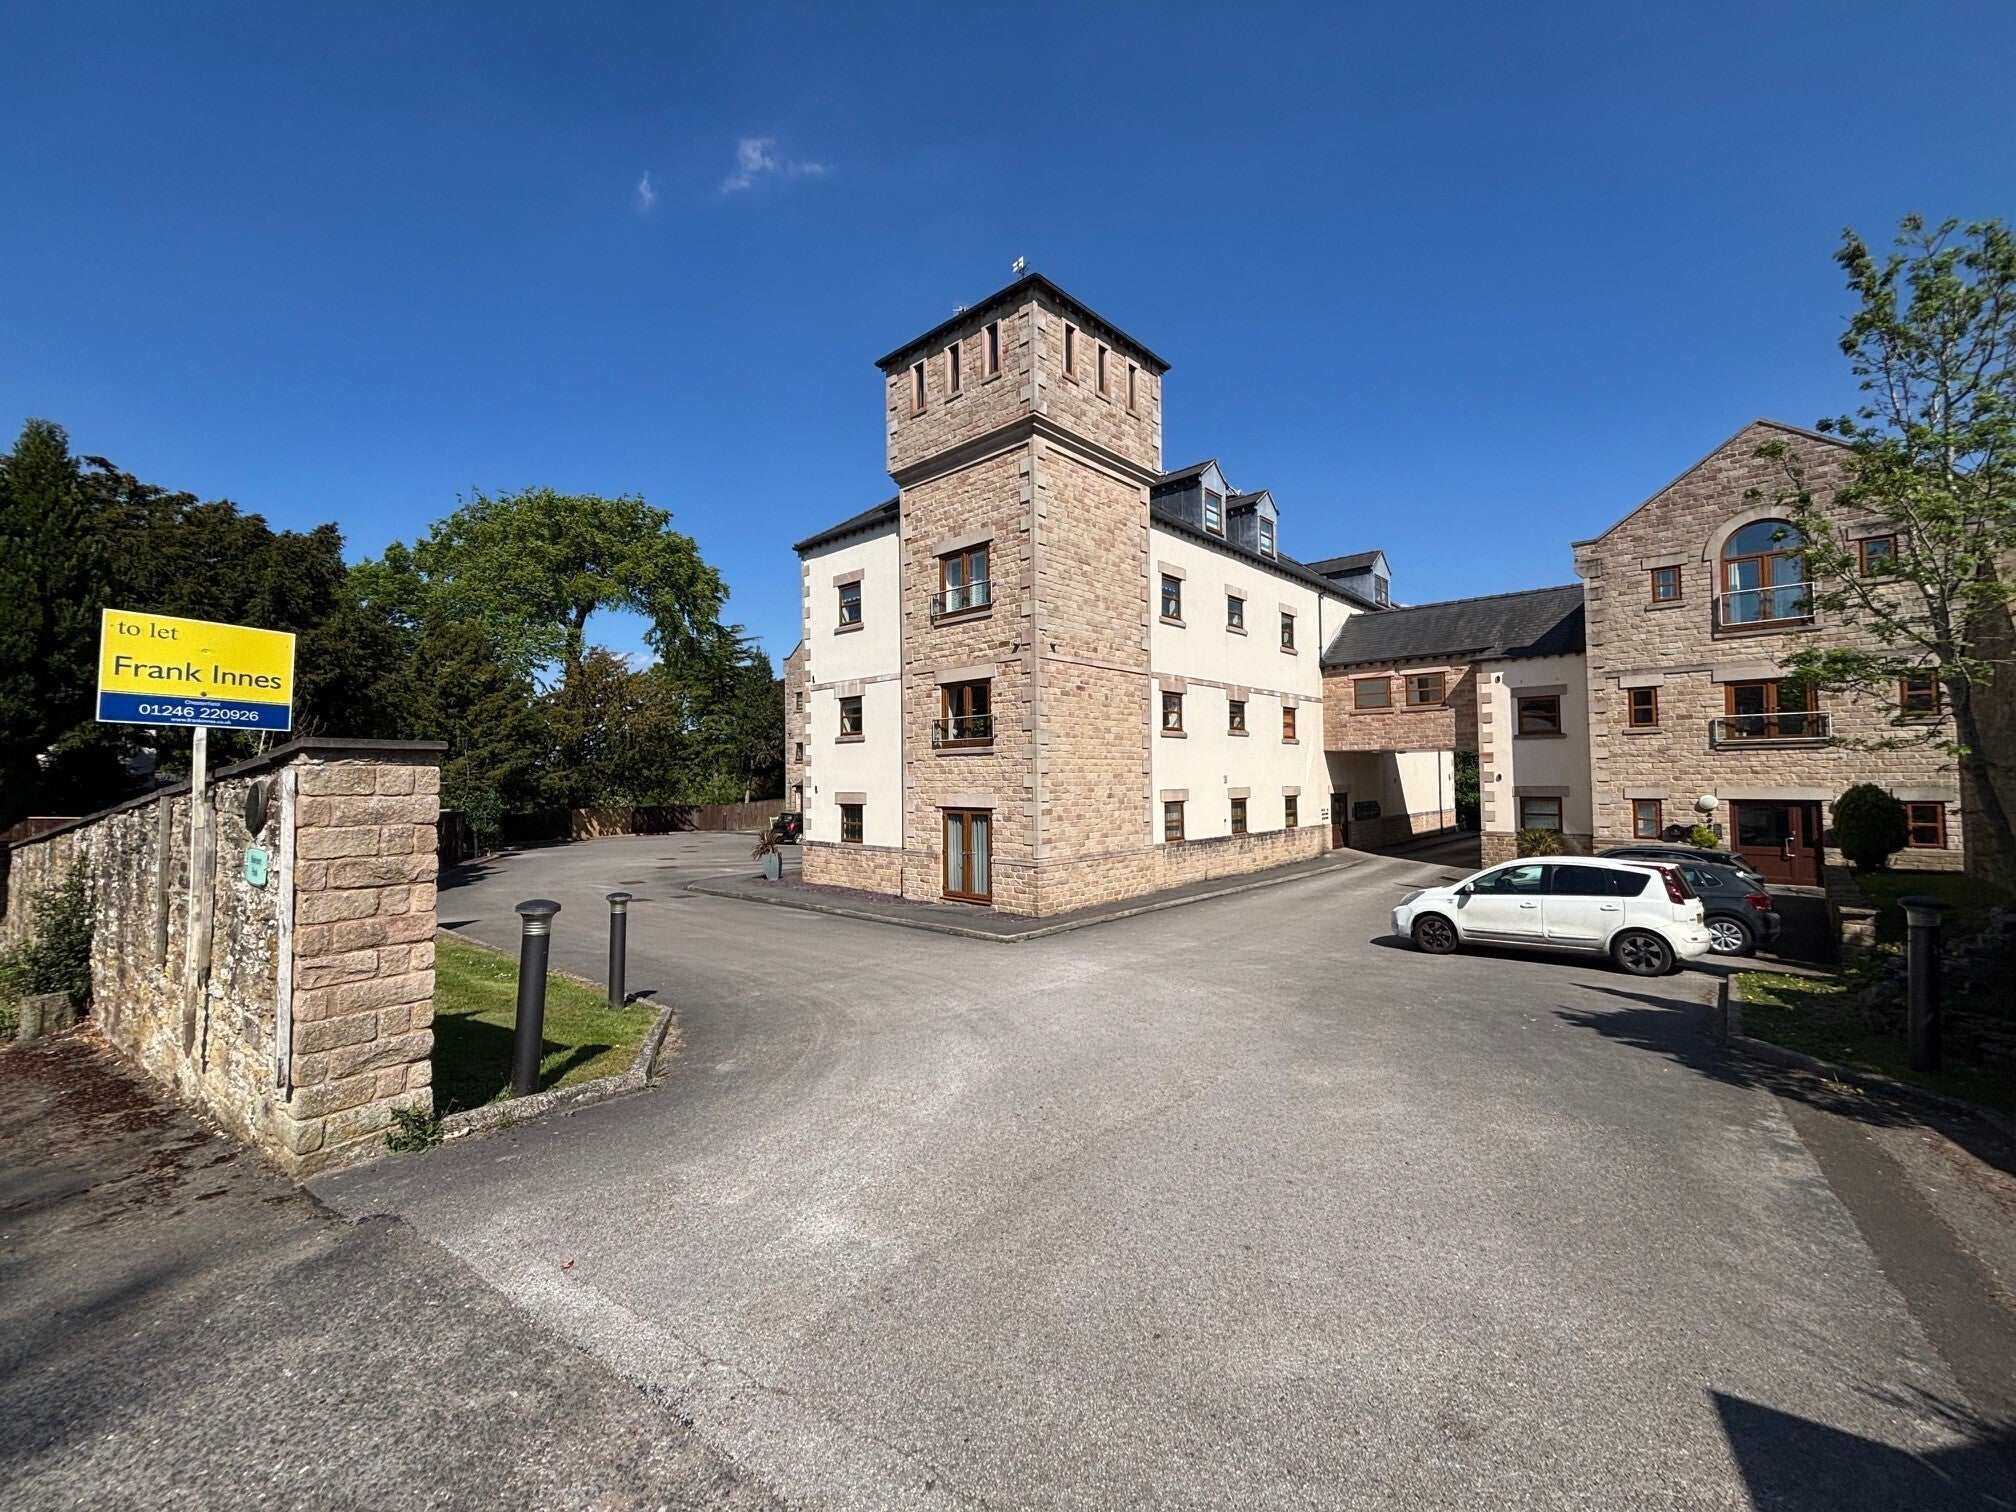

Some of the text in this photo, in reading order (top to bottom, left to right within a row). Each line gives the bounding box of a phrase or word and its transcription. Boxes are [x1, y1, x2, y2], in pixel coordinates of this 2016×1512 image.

[118, 621, 179, 641] to let
[114, 655, 282, 690] Frank Innes
[138, 703, 259, 722] 01246 220926
